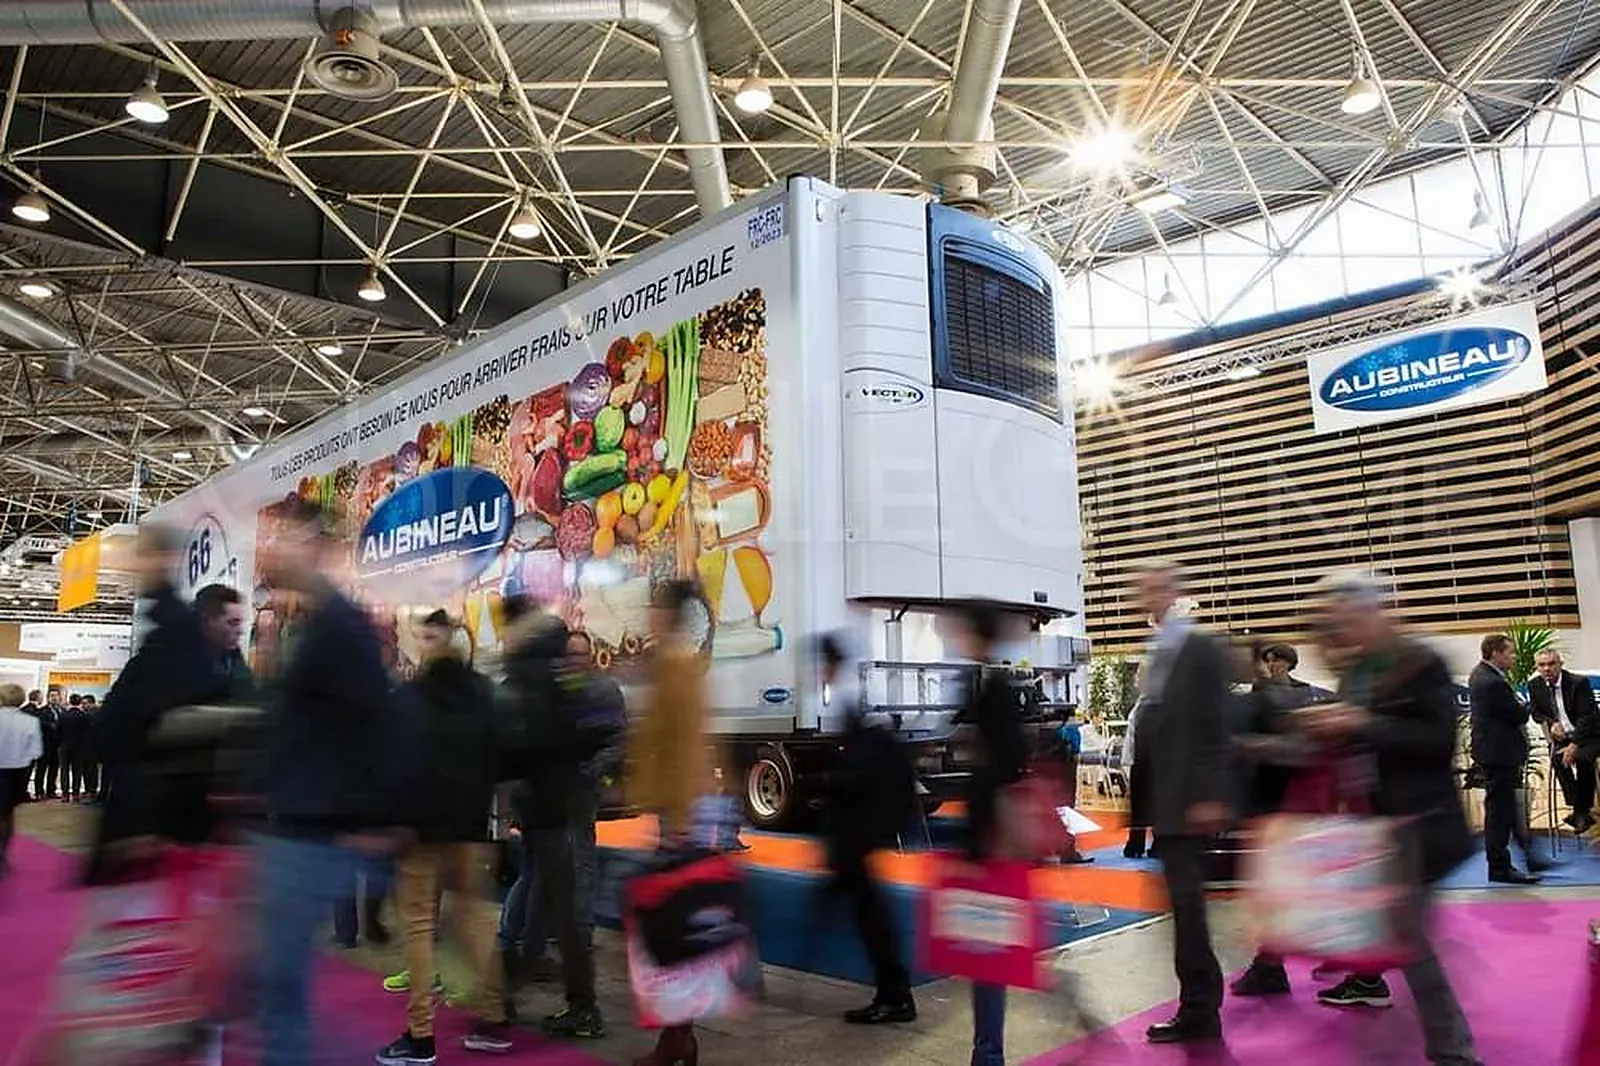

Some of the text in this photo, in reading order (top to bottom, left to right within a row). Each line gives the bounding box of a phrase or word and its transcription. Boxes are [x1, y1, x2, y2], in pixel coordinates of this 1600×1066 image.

[270, 462, 291, 480] TOUS
[303, 435, 341, 465] PRODUITS
[341, 427, 359, 449] ONT
[359, 408, 394, 441] BESOIN
[394, 402, 408, 426] DE
[408, 388, 439, 418] NOUS
[439, 372, 473, 405] POUR
[473, 345, 528, 388] ARRIVER
[530, 325, 571, 363] FRAIS
[611, 276, 669, 324] VOTRE
[673, 244, 735, 296] TABLE
[1330, 337, 1516, 399] AUBINEAU
[1380, 373, 1465, 398] CONSTRUCTEUR
[862, 389, 917, 399] VECTOR
[361, 496, 501, 565] AUBINEAU
